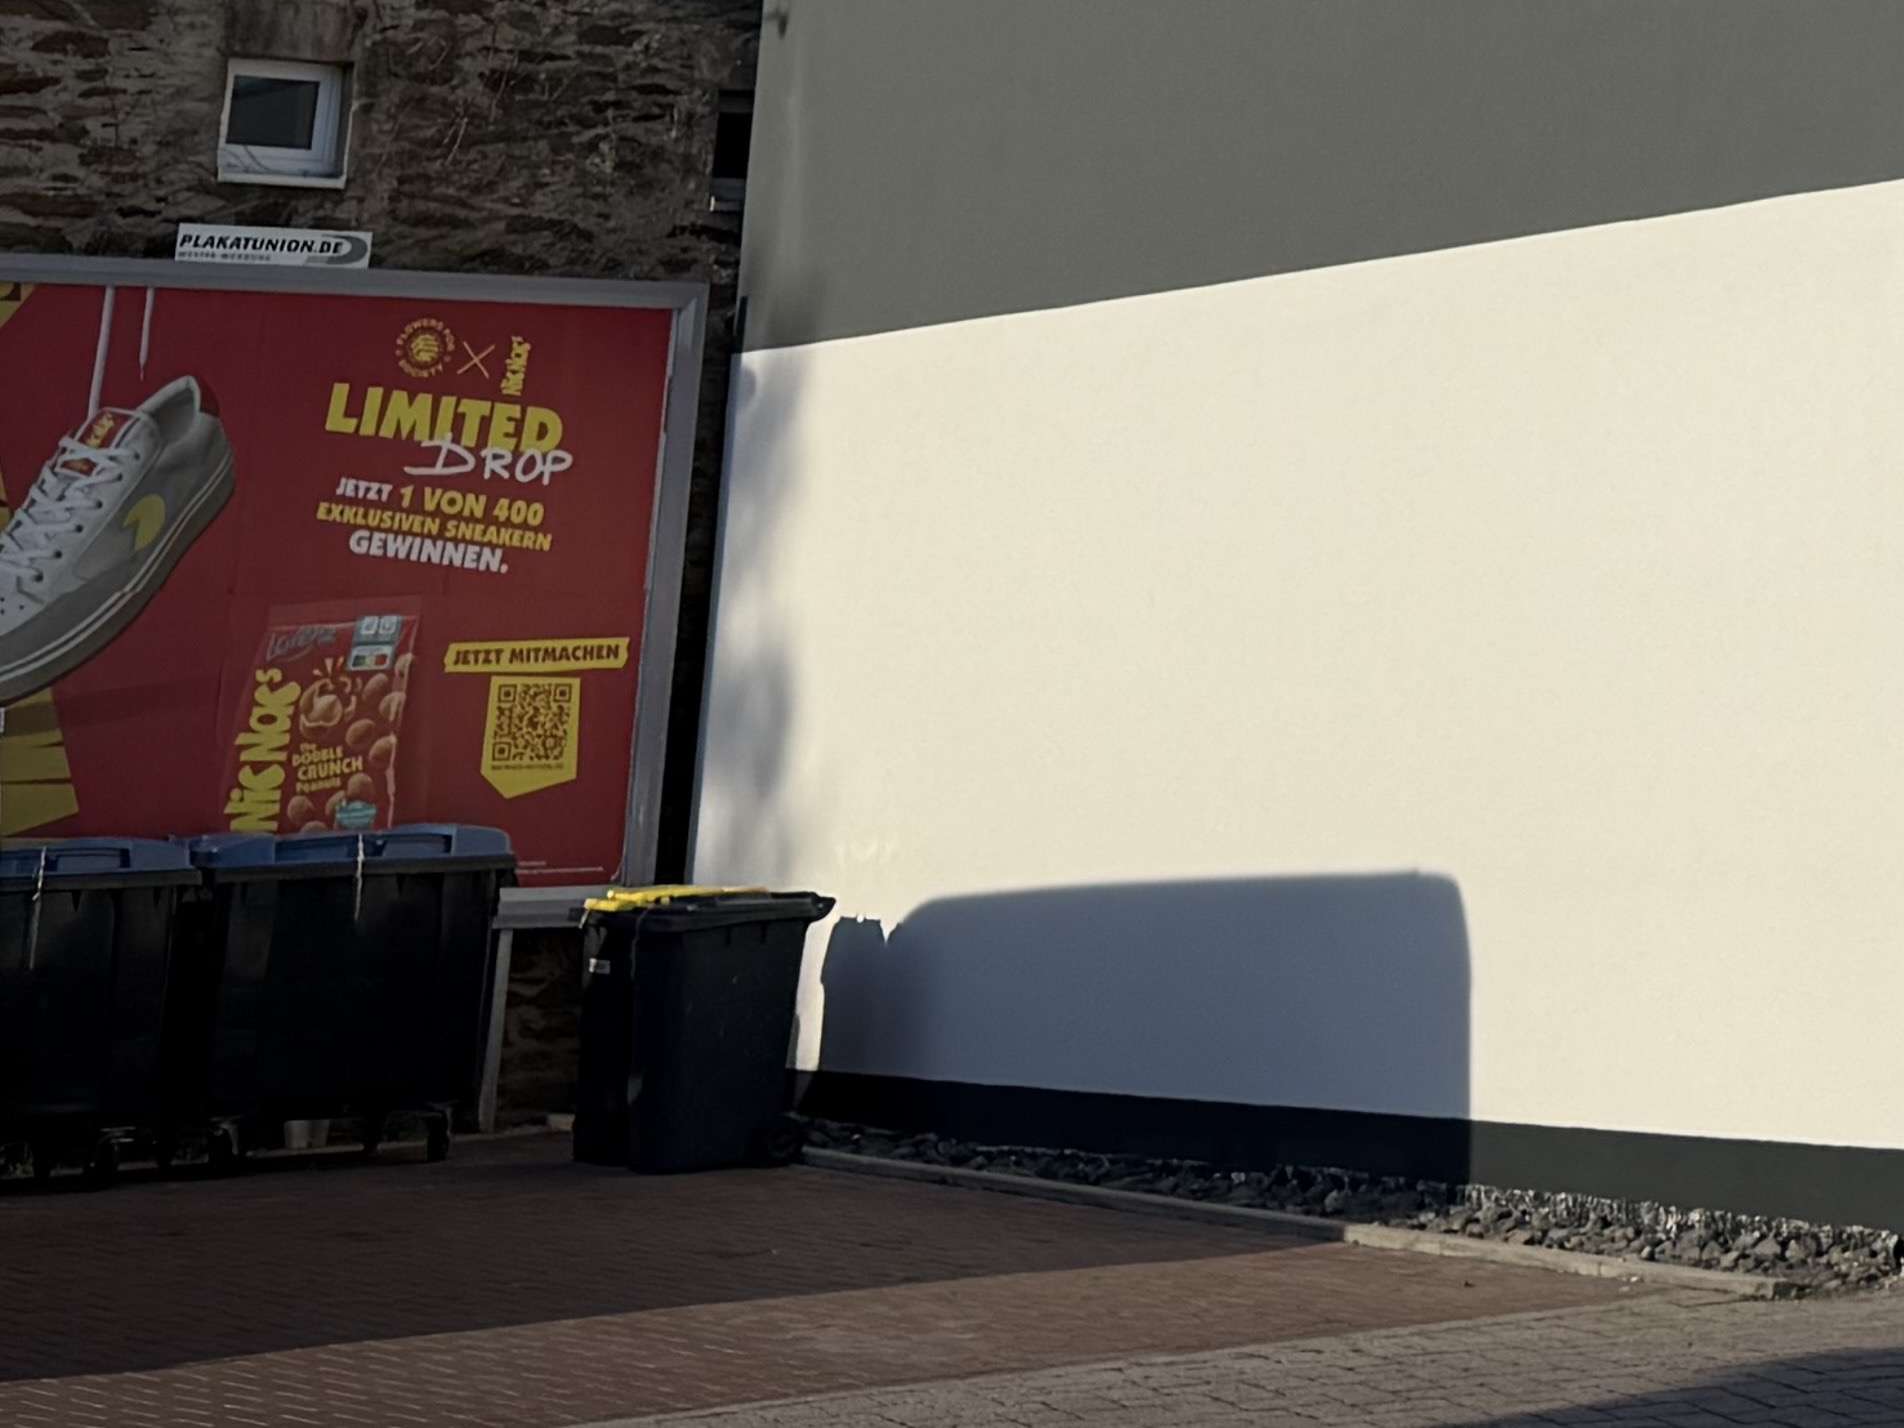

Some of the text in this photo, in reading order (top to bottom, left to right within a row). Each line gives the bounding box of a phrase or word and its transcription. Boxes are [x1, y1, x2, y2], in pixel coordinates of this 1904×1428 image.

[179, 234, 344, 254] PLAKATUNION.DE
[325, 382, 564, 454] LIMITED
[403, 432, 574, 486] DROP
[335, 476, 545, 526] JETZT 1 VON 400
[316, 501, 553, 552] EXKLUSIVEN SNEAKERN
[349, 528, 509, 574] GEWINNEN.
[453, 644, 621, 666] JETZT MITMACHEN
[297, 755, 363, 781] CRUNCH
